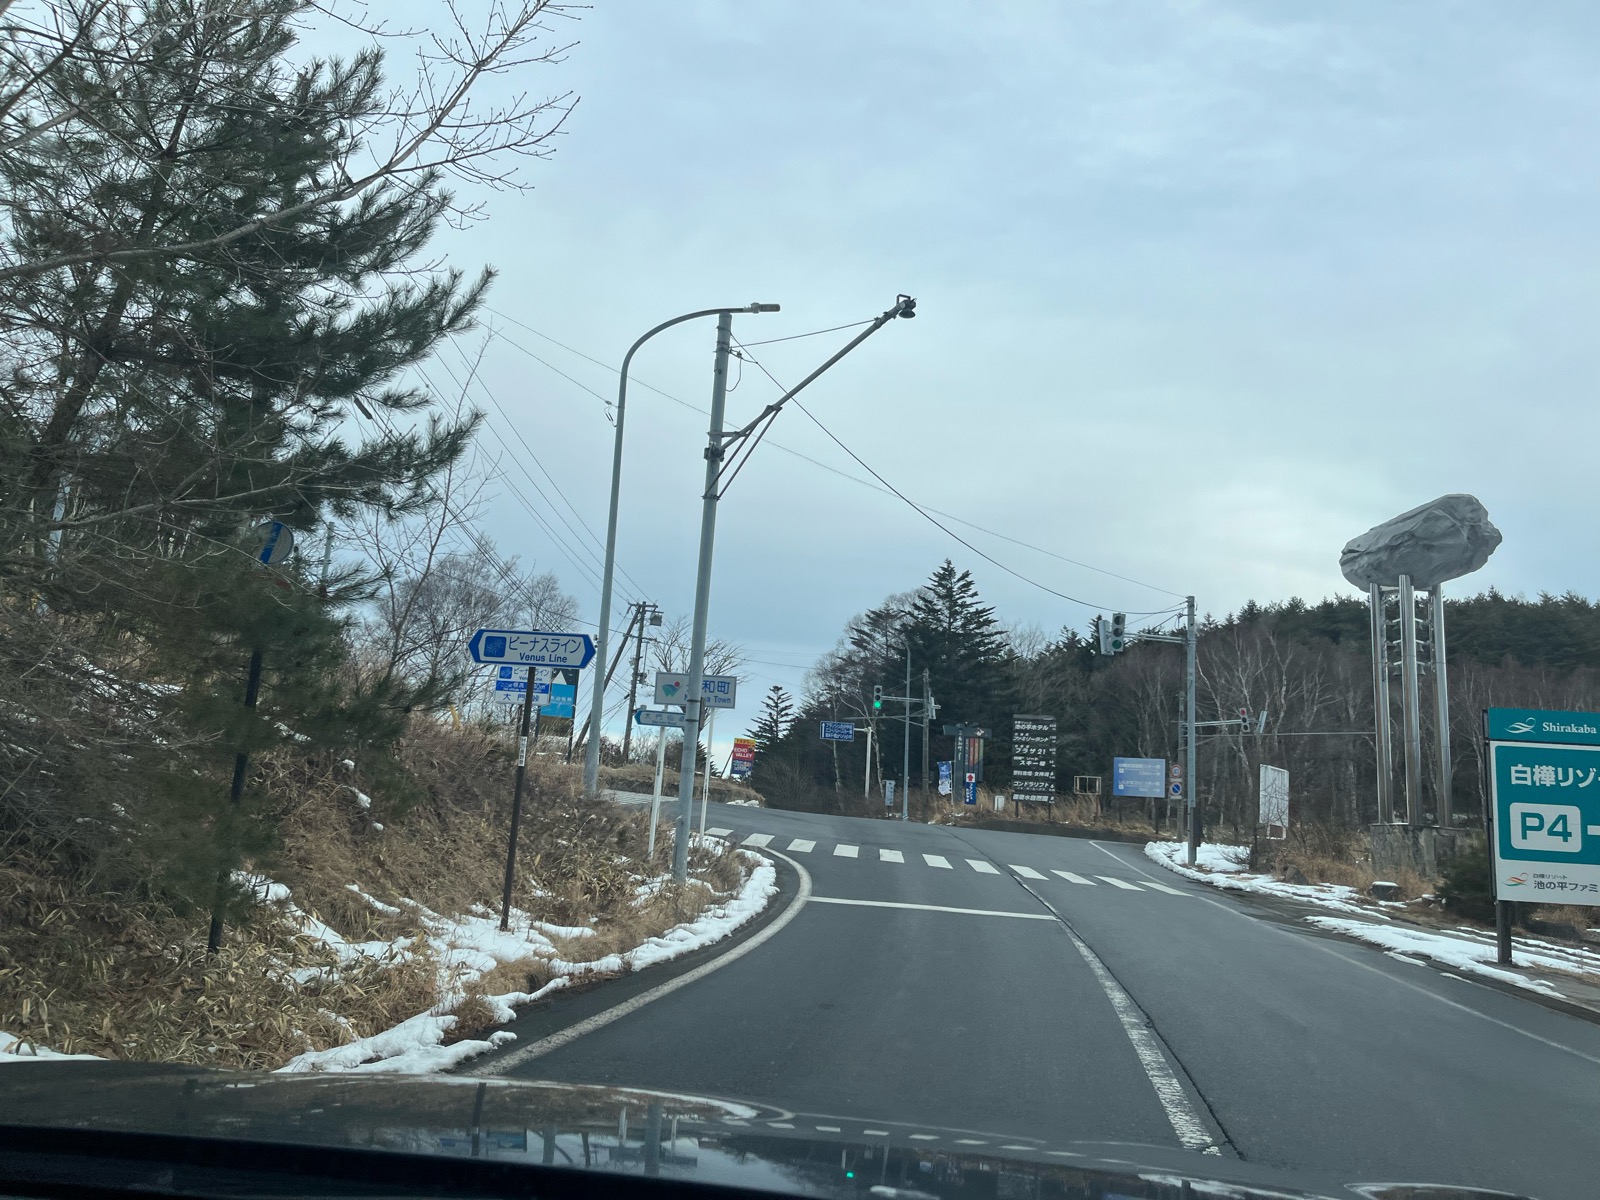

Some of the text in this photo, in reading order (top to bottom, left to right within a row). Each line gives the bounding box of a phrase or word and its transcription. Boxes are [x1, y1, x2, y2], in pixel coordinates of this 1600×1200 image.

[508, 636, 581, 654] ビーナスライン
[520, 652, 568, 663] Venus Line
[702, 680, 731, 695] 和町
[1542, 721, 1598, 734] Shirakaba
[1510, 764, 1600, 789] 白樺リゾ
[1520, 812, 1572, 842] P4
[1533, 880, 1599, 893] 池の平ファミ
